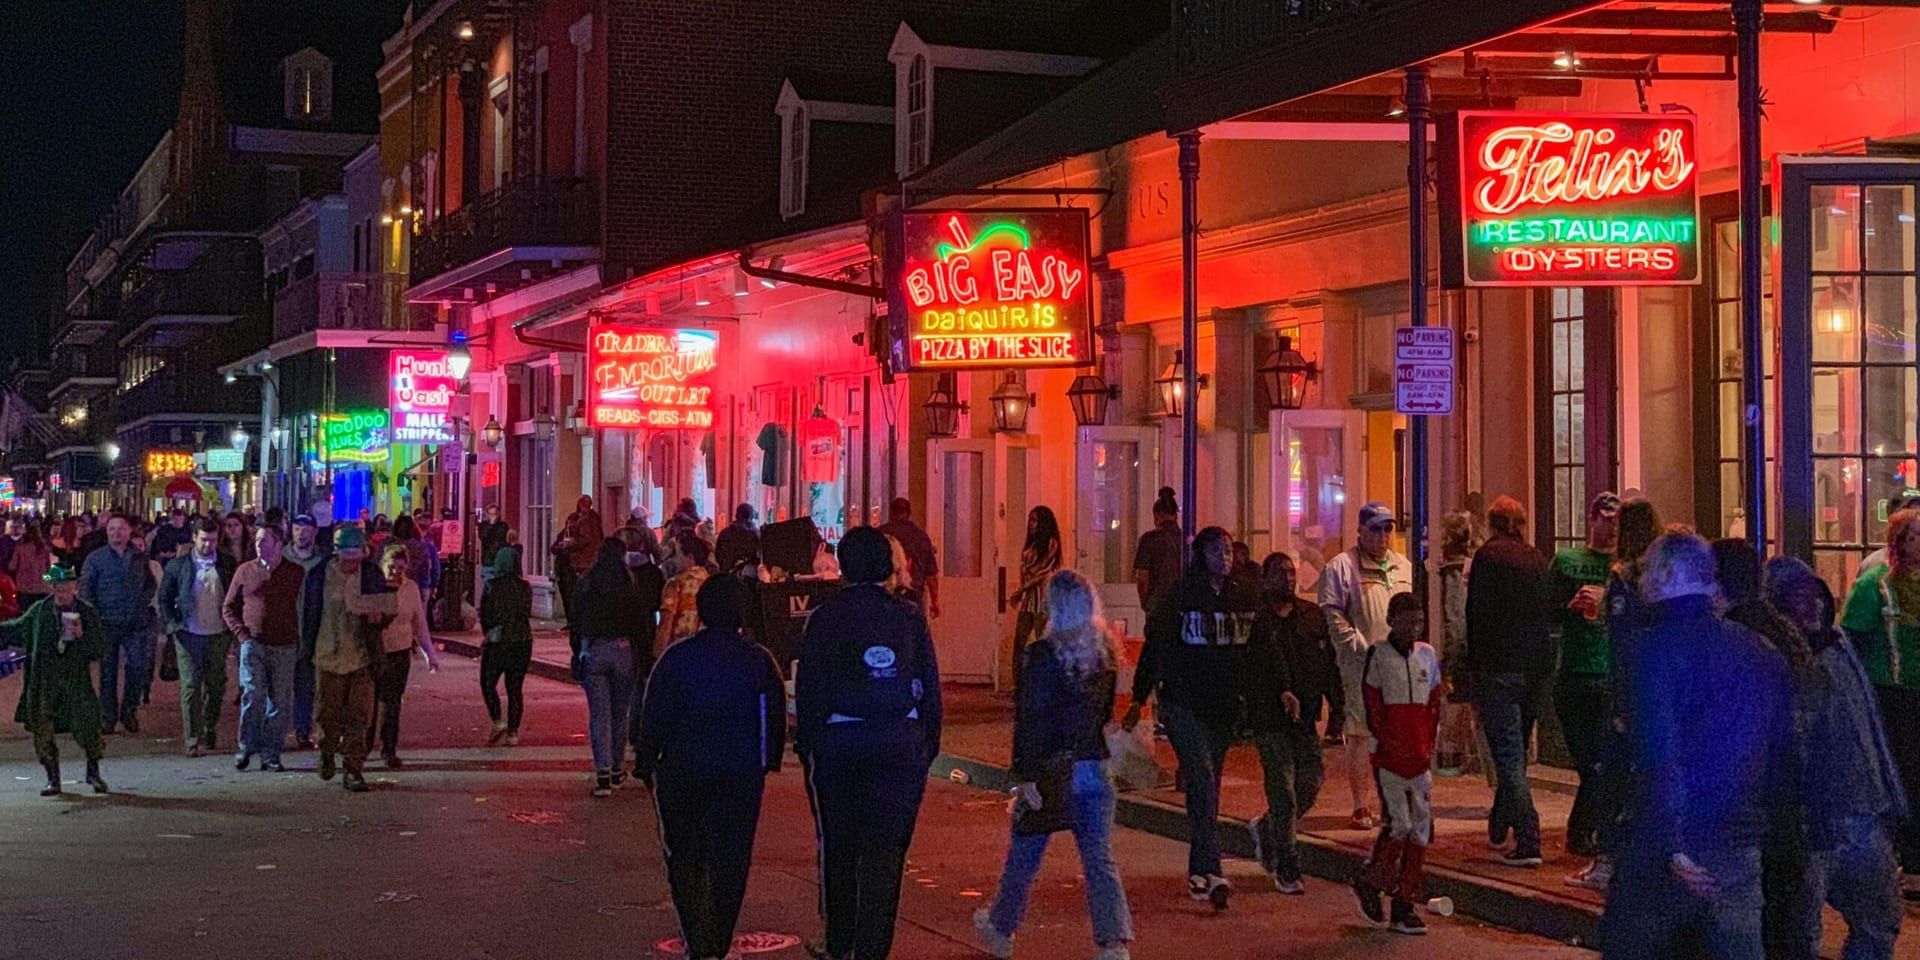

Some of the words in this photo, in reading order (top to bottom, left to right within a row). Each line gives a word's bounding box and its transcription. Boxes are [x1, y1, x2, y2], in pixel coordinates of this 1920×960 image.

[1475, 122, 1694, 213] Felix's
[1480, 218, 1694, 241] RESTAURANT
[1507, 247, 1675, 271] OYSTERS
[906, 255, 980, 306] BIG
[991, 249, 1082, 301] EASY
[595, 330, 677, 353] TRADERS
[920, 338, 967, 360] PIZZA
[969, 337, 990, 359] BY
[993, 336, 1025, 359] THE
[1028, 336, 1074, 359] SLICE
[1397, 332, 1414, 344] NO
[1415, 331, 1450, 343] PARKING
[596, 347, 718, 392] EMPORIUM
[1397, 368, 1414, 380] NO
[1415, 368, 1450, 379] PARKING
[640, 384, 711, 405] OUTLET
[789, 594, 811, 611] IV
